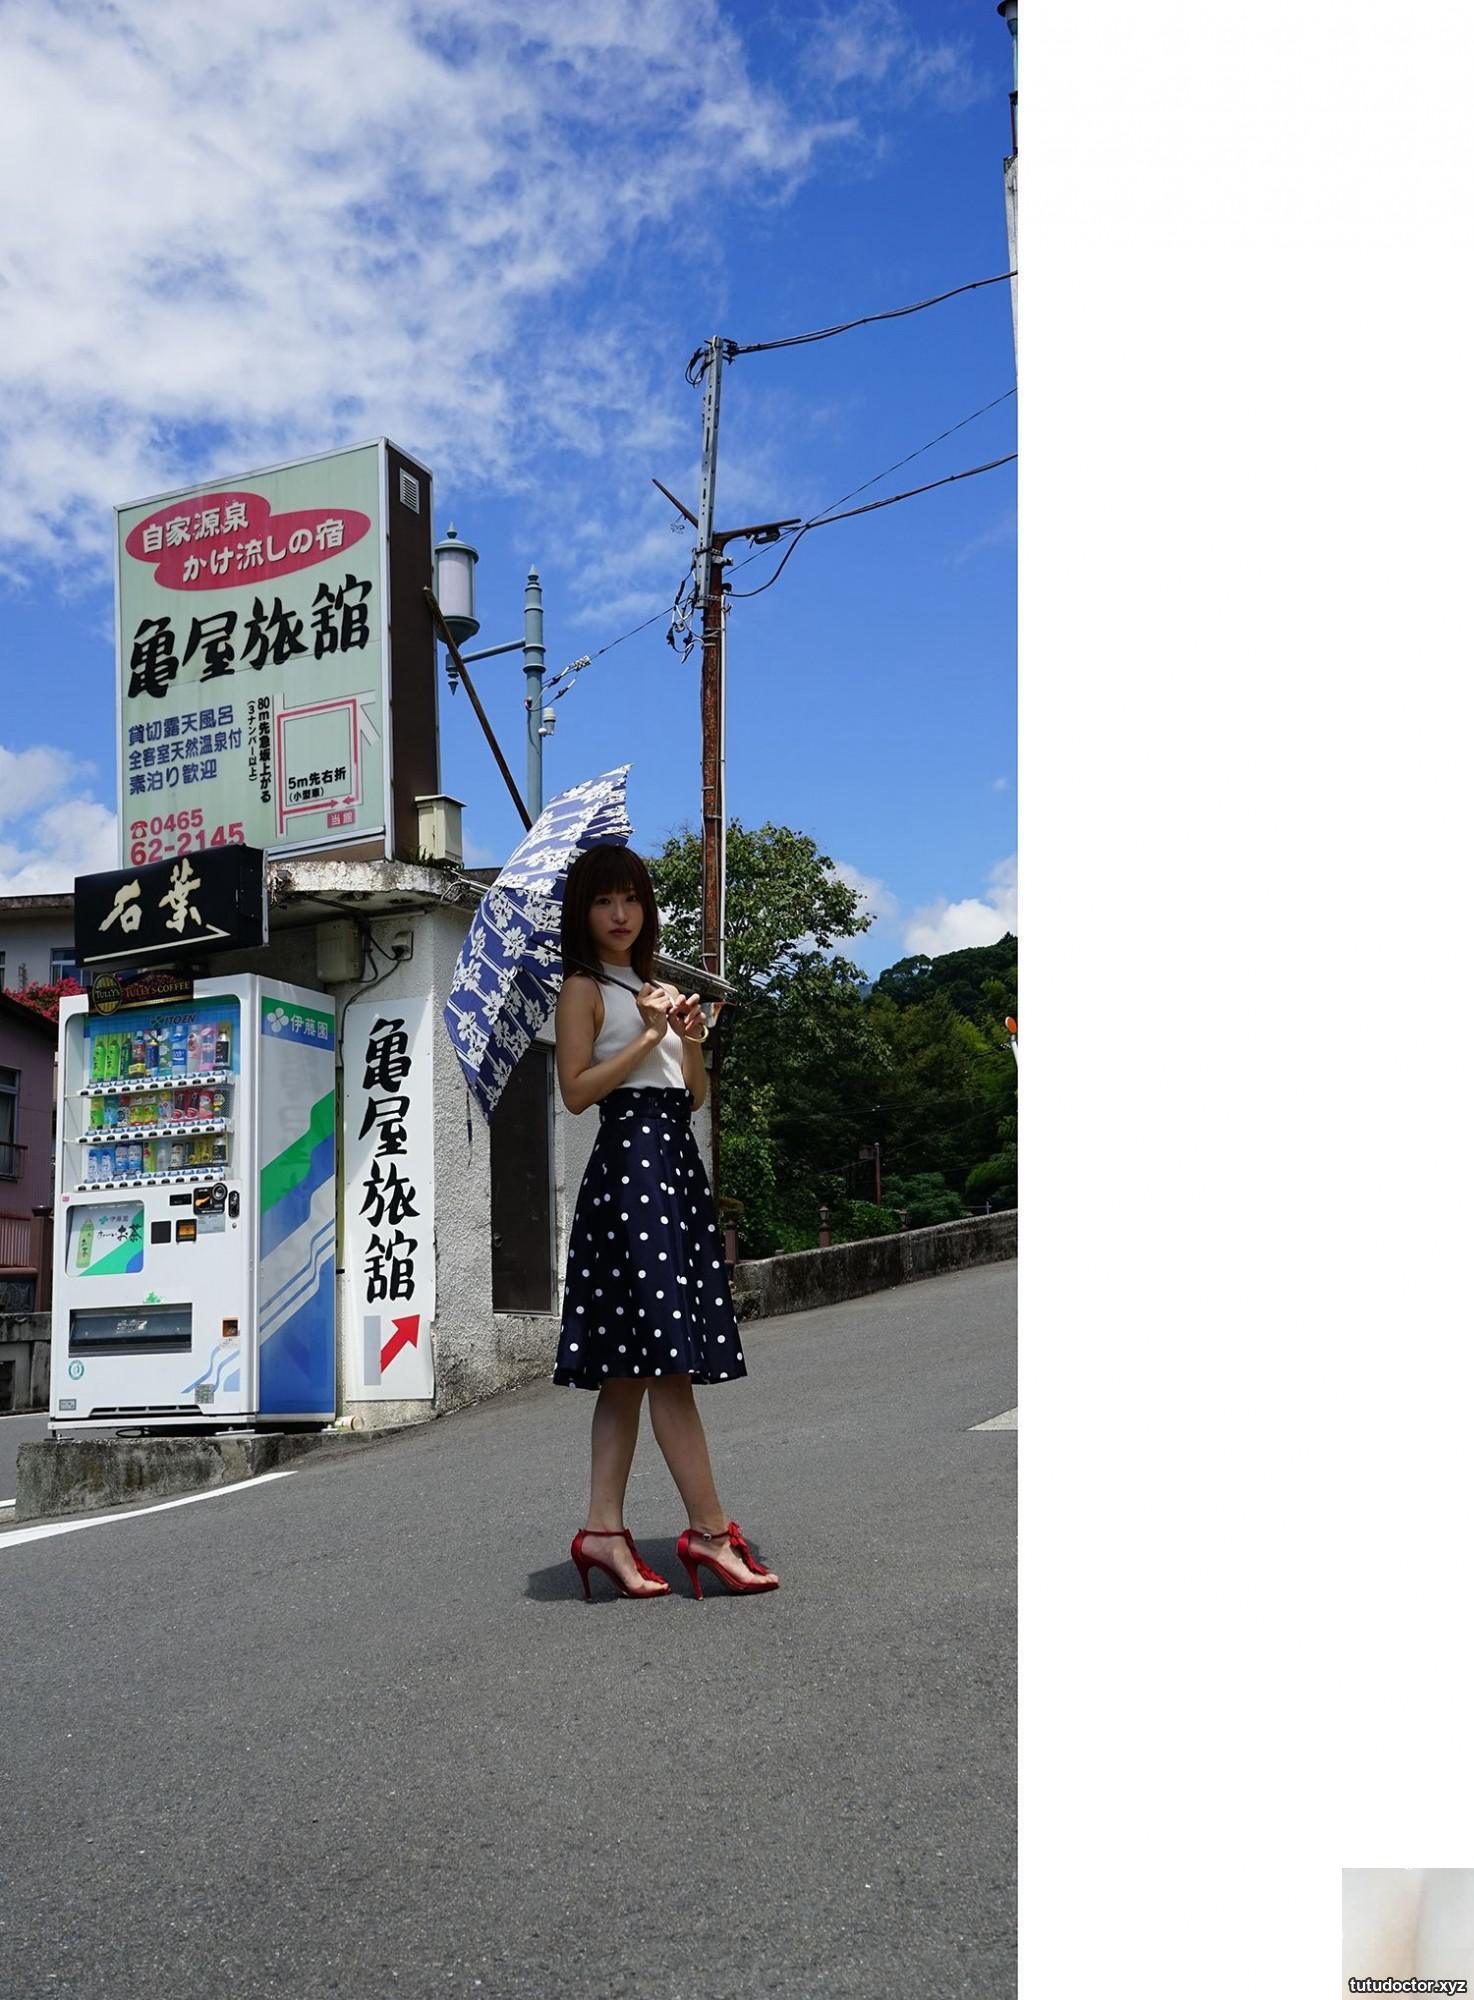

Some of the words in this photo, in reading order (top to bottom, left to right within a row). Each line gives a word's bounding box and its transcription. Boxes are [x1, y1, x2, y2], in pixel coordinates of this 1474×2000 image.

[142, 501, 248, 553] 自家源泉
[183, 519, 345, 583] かけ流しの宿
[128, 705, 234, 746] 貸切露天風呂
[129, 728, 242, 771] 全客室天然温泉付
[288, 766, 346, 789] 5m先右折
[150, 808, 203, 835] 0465
[130, 822, 245, 866] 62-2145
[291, 1014, 328, 1040] 伊藤園
